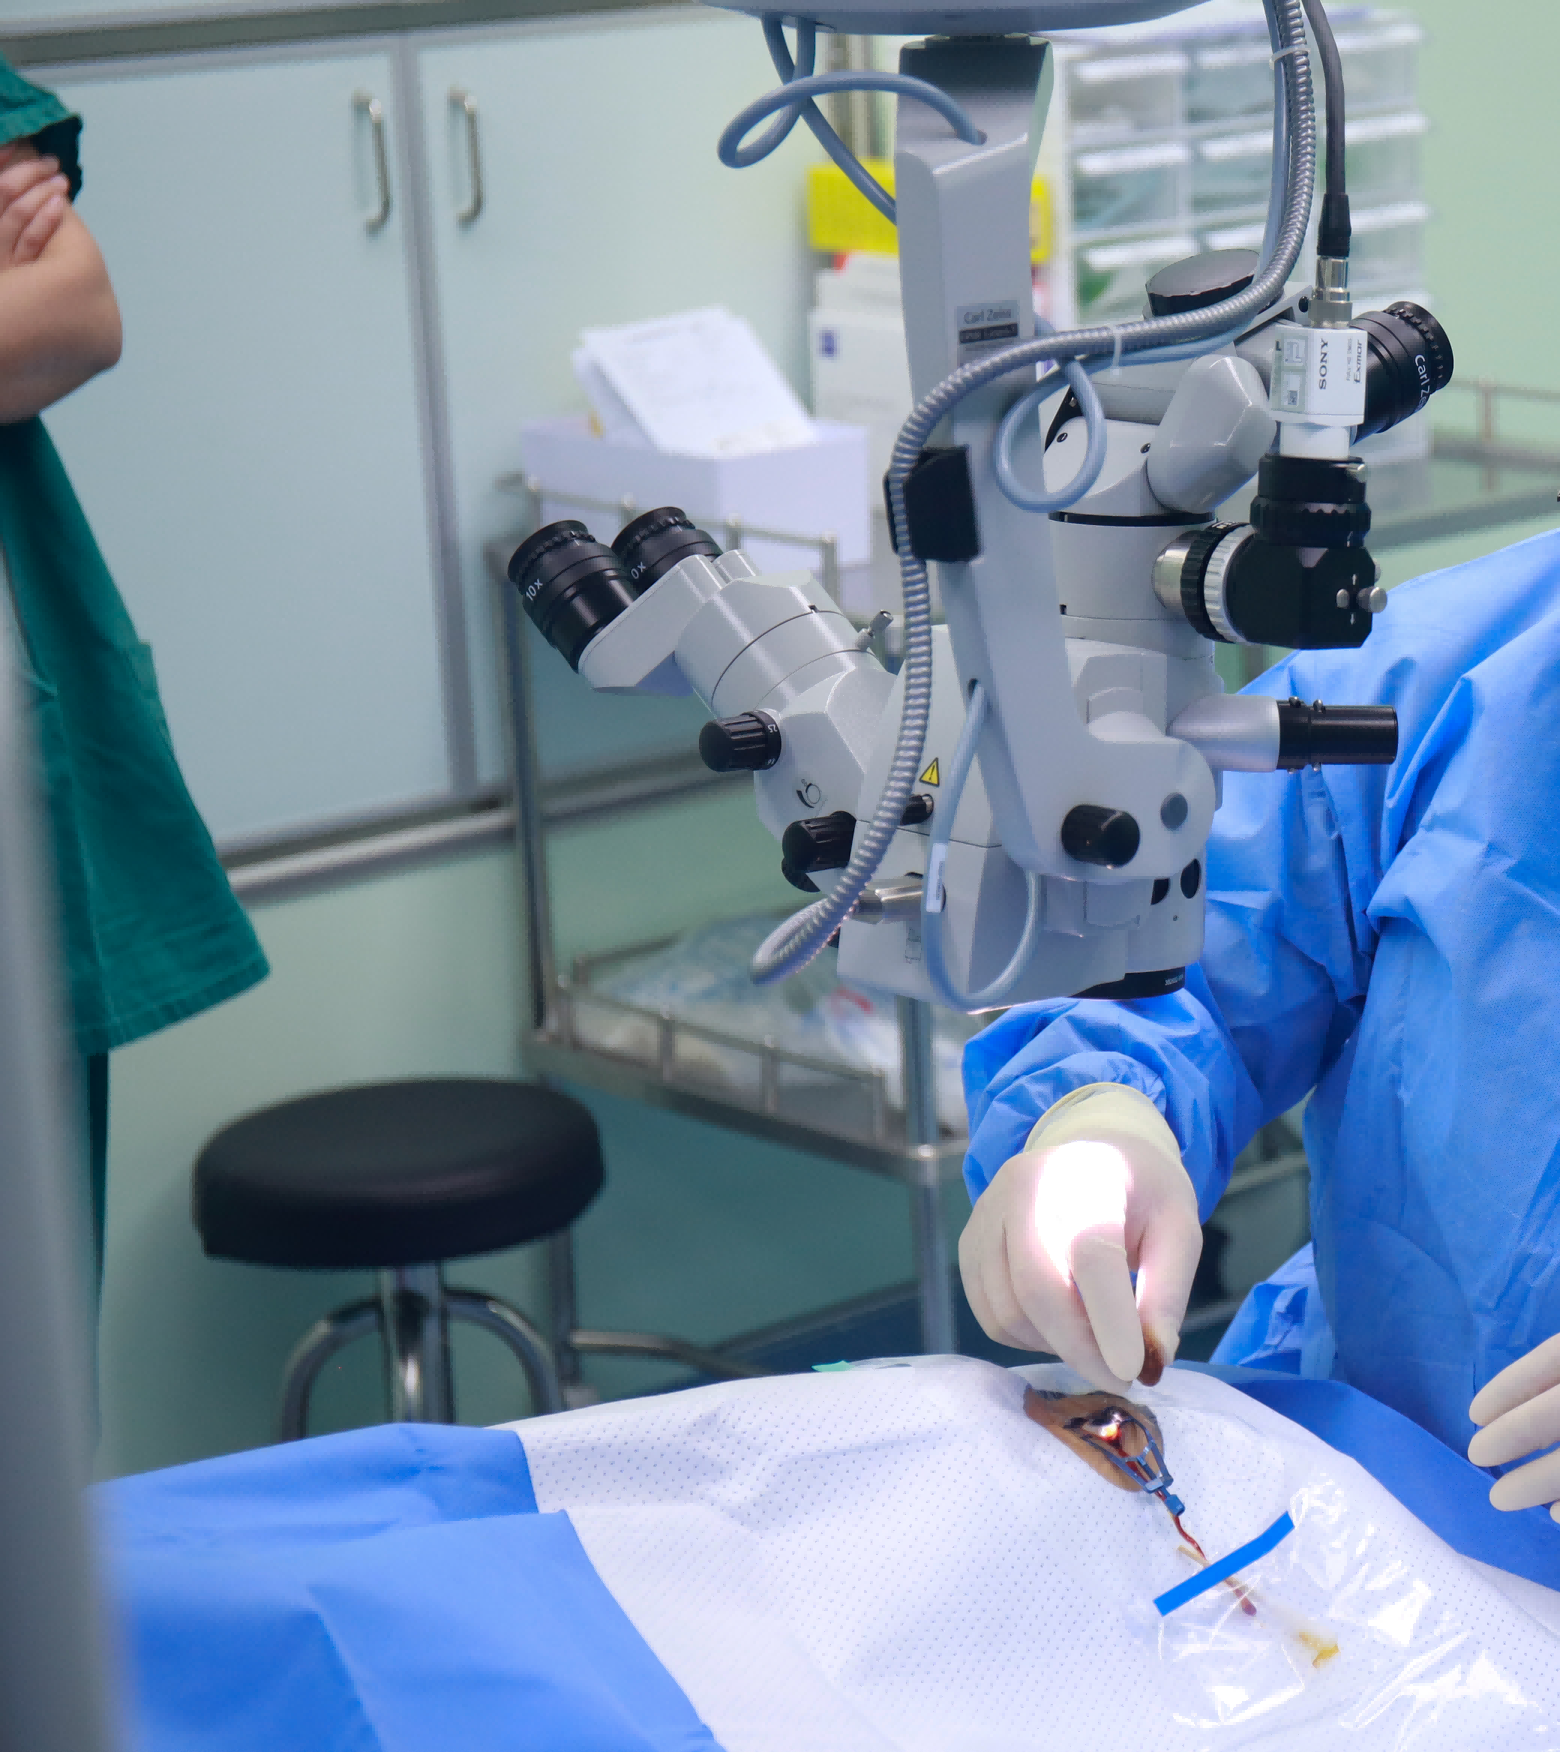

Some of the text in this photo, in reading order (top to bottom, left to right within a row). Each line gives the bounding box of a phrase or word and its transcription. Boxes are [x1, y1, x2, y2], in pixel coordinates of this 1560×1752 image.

[1319, 338, 1328, 390] SONY
[1414, 354, 1430, 386] Carl
[630, 561, 647, 580] 0x
